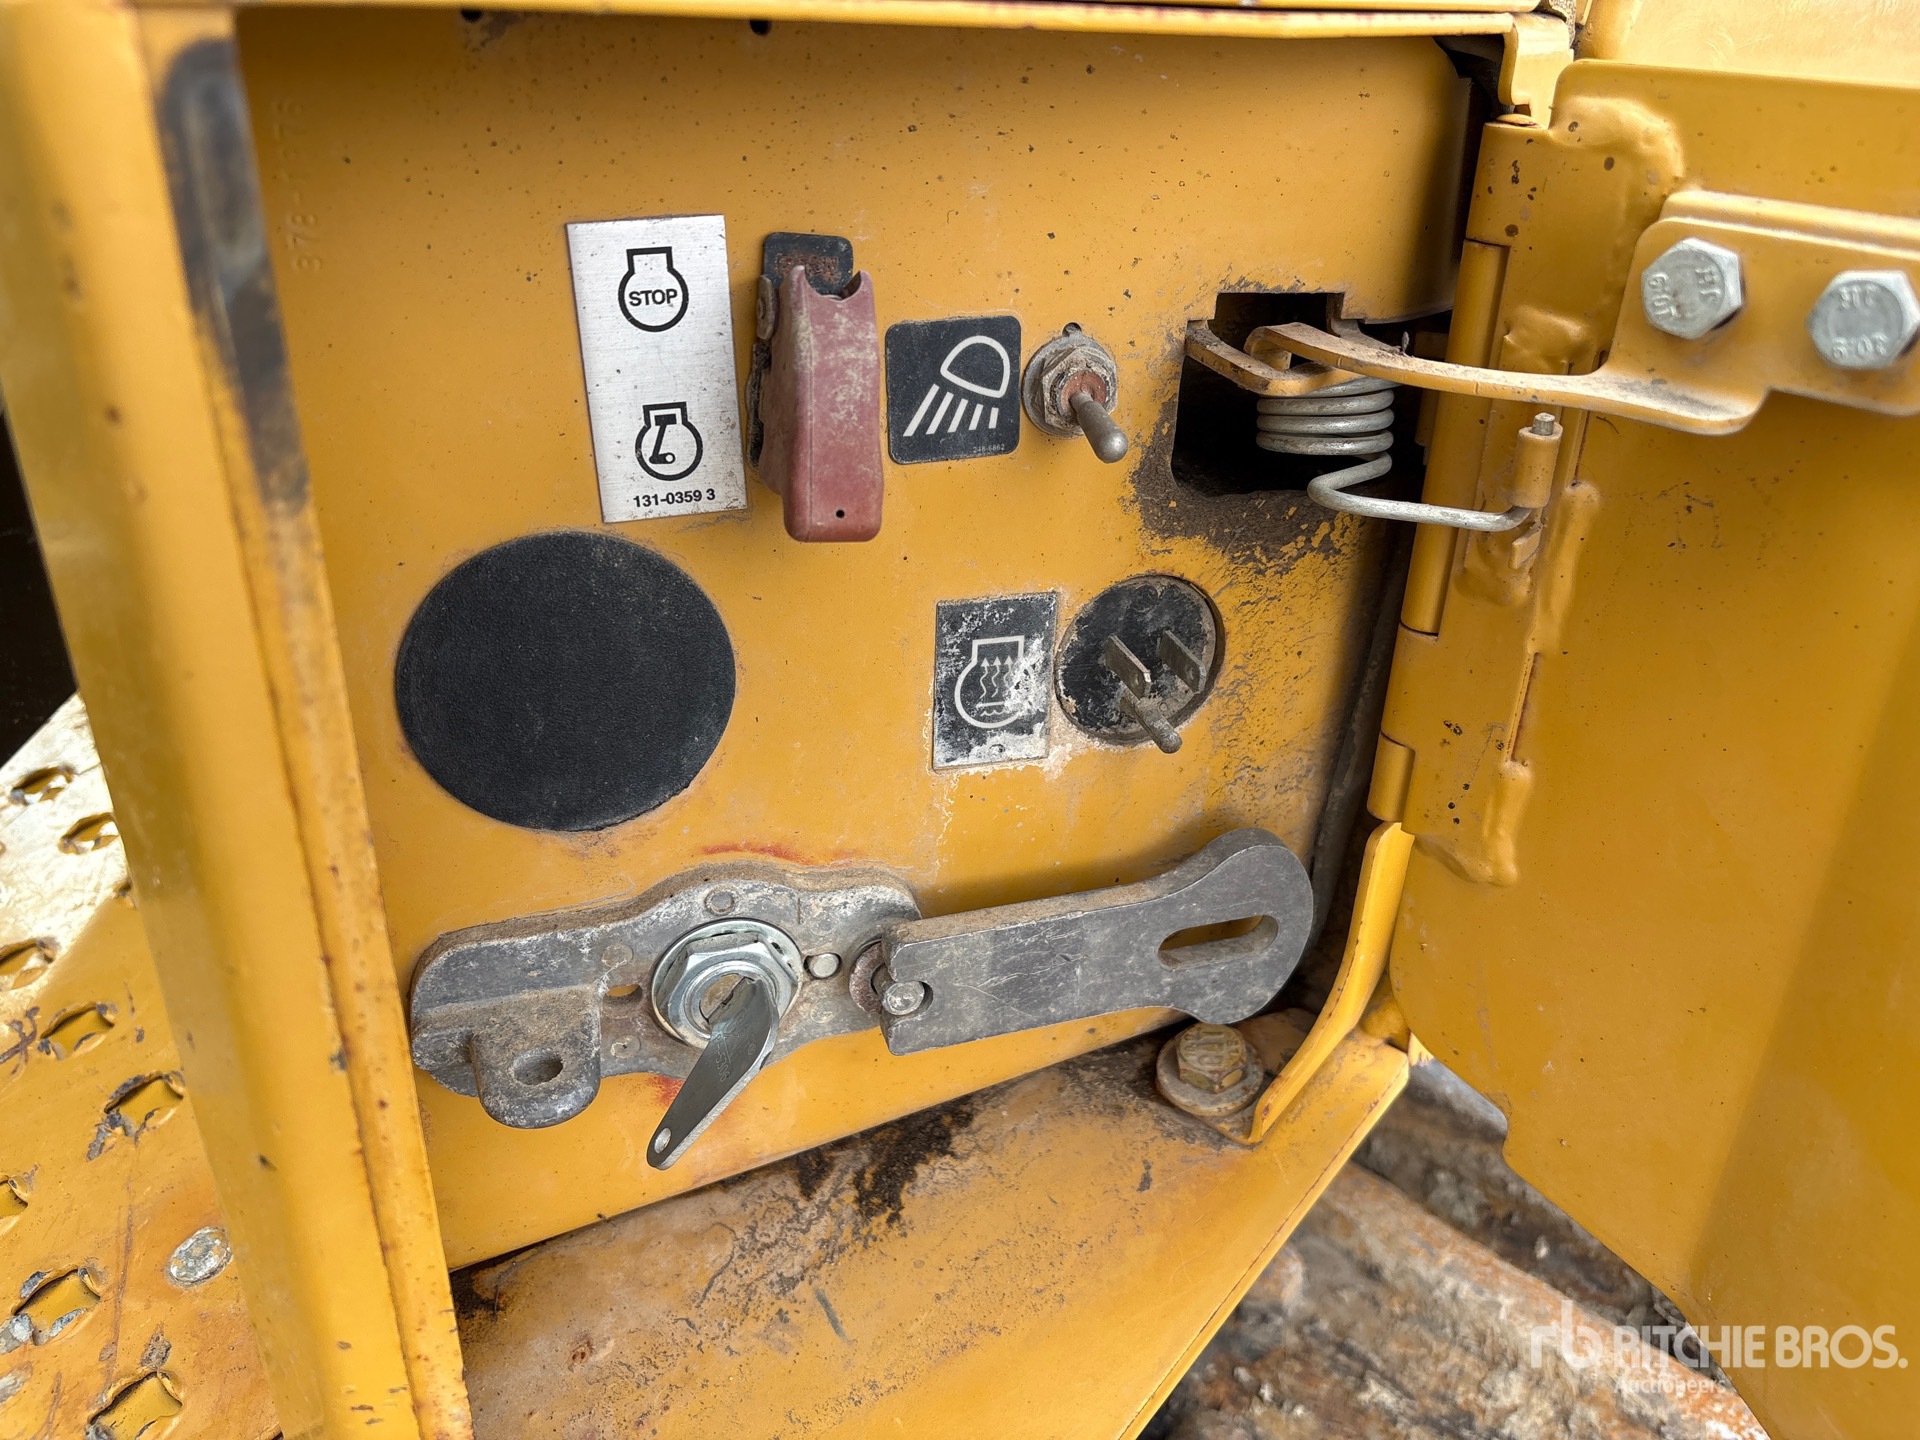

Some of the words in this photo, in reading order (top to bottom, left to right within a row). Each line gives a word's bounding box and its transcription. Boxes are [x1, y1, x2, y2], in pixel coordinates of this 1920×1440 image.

[628, 288, 678, 307] STOP
[633, 489, 702, 508] 131-0359
[705, 488, 716, 502] 3
